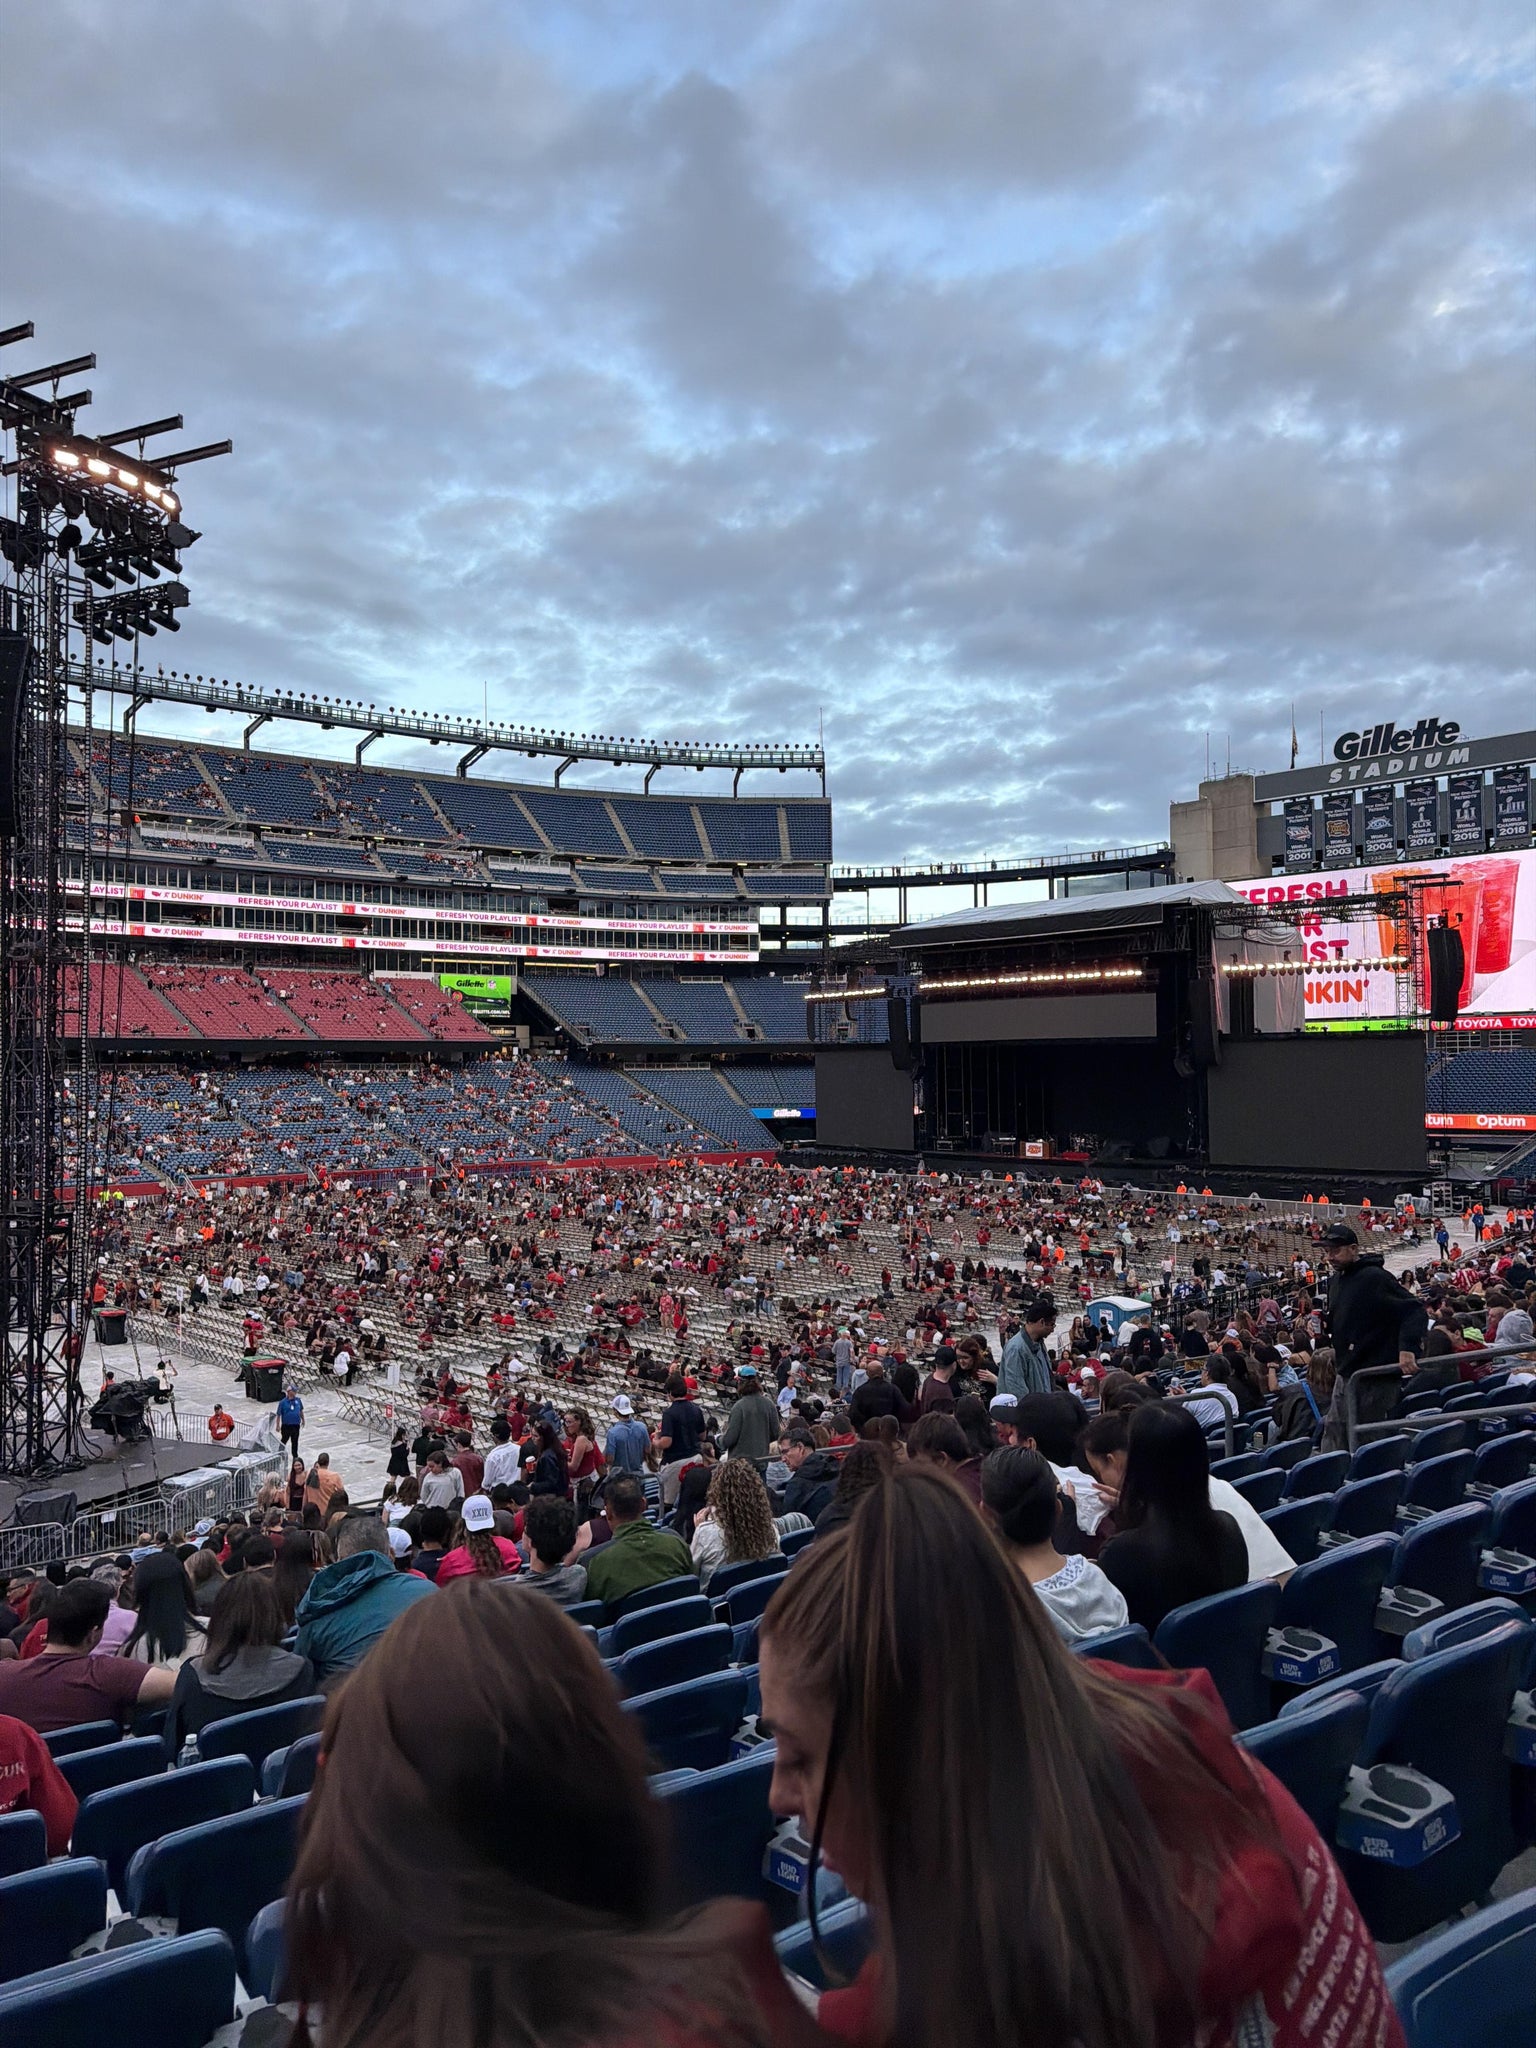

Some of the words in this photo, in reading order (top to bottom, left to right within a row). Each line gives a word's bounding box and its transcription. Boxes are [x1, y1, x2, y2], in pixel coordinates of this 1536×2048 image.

[1333, 717, 1460, 762] Gillette
[1328, 747, 1470, 784] STADIUM
[1412, 820, 1432, 828] XLIX
[1499, 826, 1526, 836] 2018
[1410, 837, 1434, 846] 2014
[1454, 832, 1480, 841] 2016
[1326, 848, 1352, 856] 2003
[1366, 842, 1393, 852] 2004
[1288, 852, 1311, 861] 2001
[171, 892, 204, 900] DUNKIN'
[238, 896, 274, 906] REFRESH
[276, 900, 300, 908] YOUR
[301, 902, 338, 910] PLAYLIST
[436, 912, 468, 920] REFRESH
[171, 928, 204, 936] DUNKIN'
[238, 932, 274, 941] REFRESH
[276, 934, 300, 942] YOUR
[301, 936, 338, 944] PLAYLIST
[456, 979, 484, 988] Gillette
[1456, 1018, 1503, 1028] TOYOTA
[1510, 1018, 1536, 1027] TOY
[1426, 1114, 1454, 1126] tum
[1476, 1115, 1526, 1128] Optum
[1282, 1662, 1298, 1670] BUD
[1280, 1668, 1302, 1678] LIGHT
[1363, 1836, 1388, 1848] BUD
[1360, 1844, 1394, 1859] LIGHT
[780, 1862, 797, 1875] BUD
[778, 1867, 800, 1884] LIGHT
